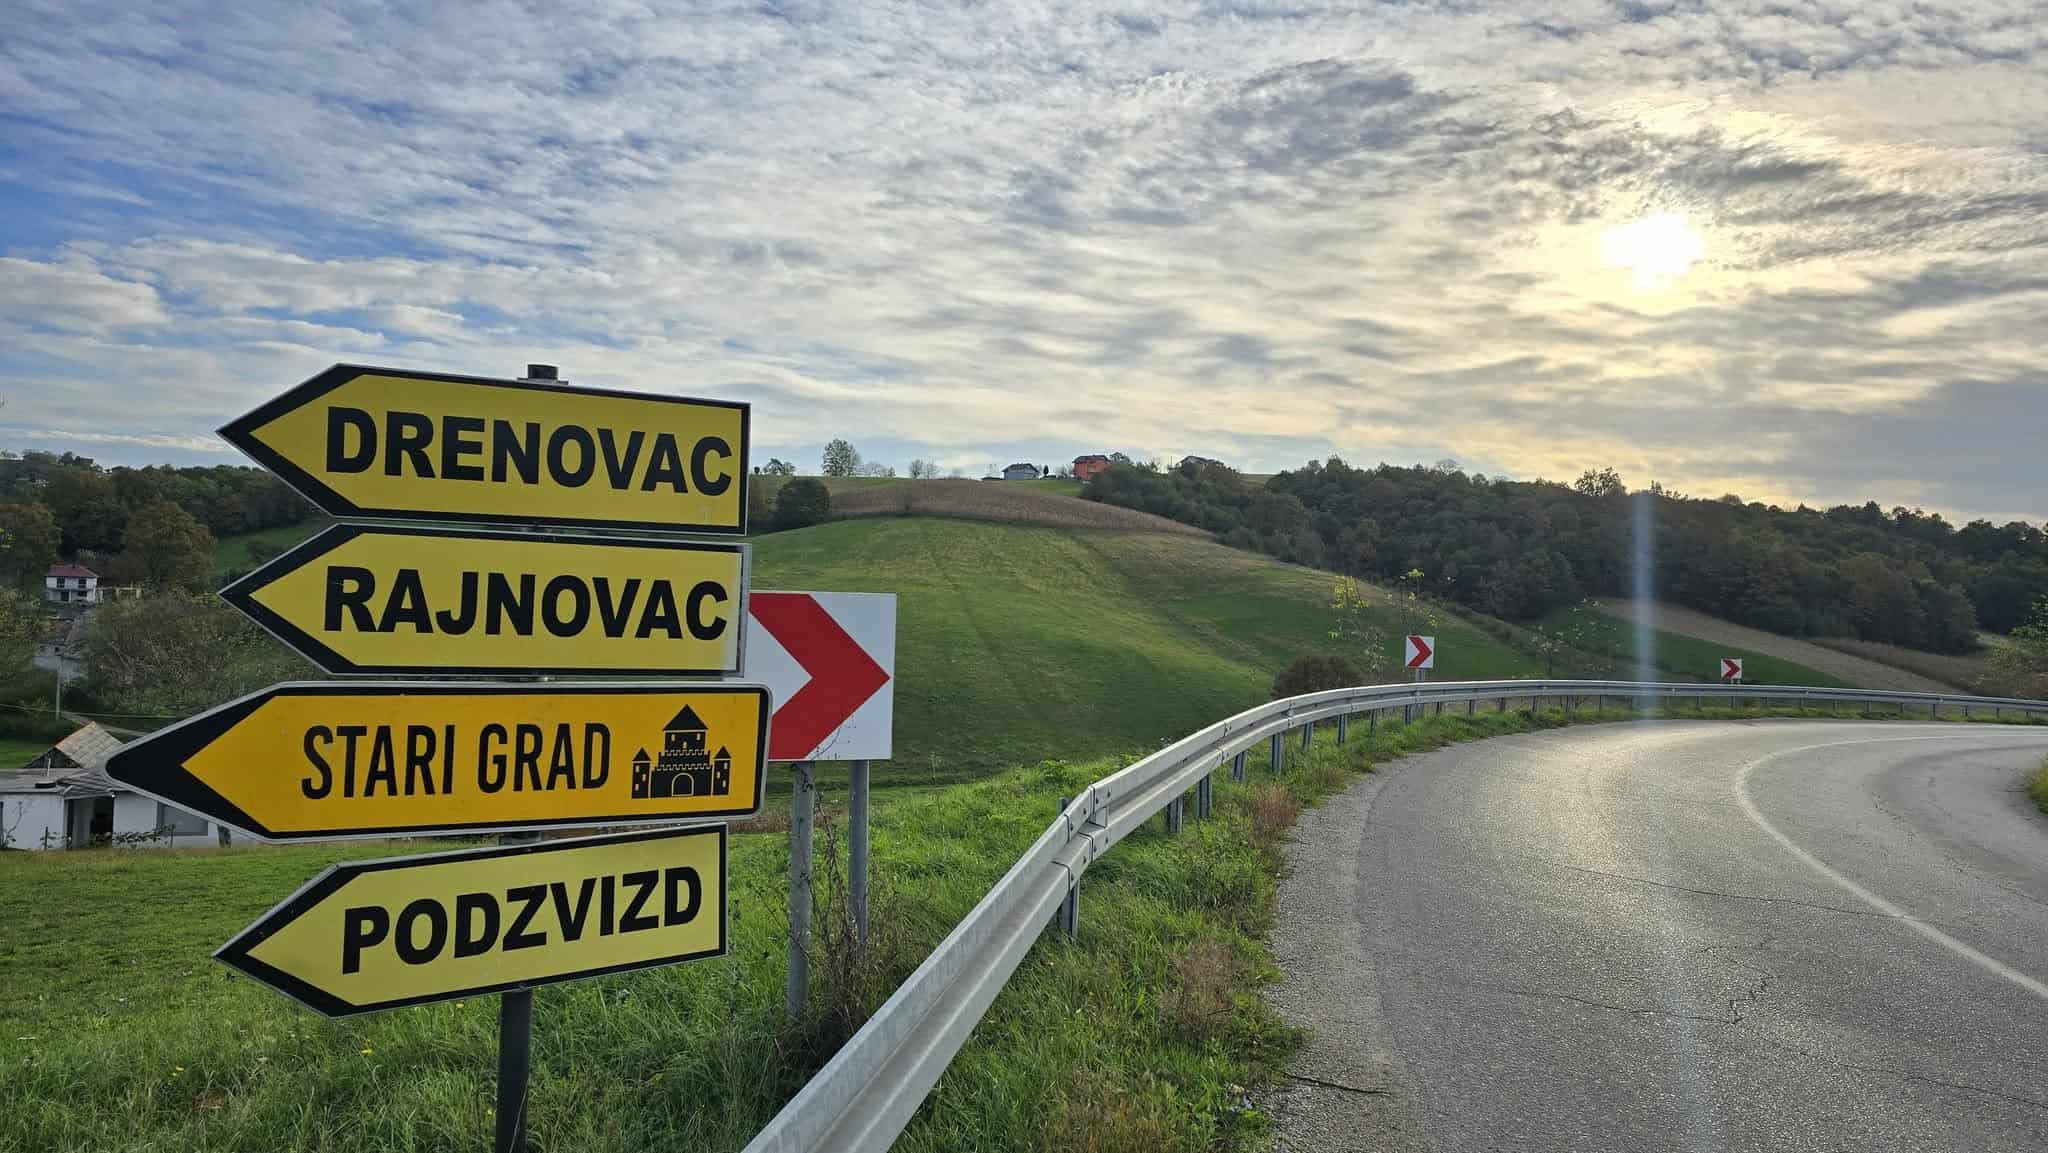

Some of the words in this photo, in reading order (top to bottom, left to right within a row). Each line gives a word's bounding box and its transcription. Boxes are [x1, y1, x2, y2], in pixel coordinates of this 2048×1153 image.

[326, 406, 732, 496] DRENOVAC
[324, 566, 728, 640] RAJNOVAC
[302, 725, 455, 799] STARI
[478, 723, 610, 793] GRAD
[342, 867, 701, 975] PODZVIZD
